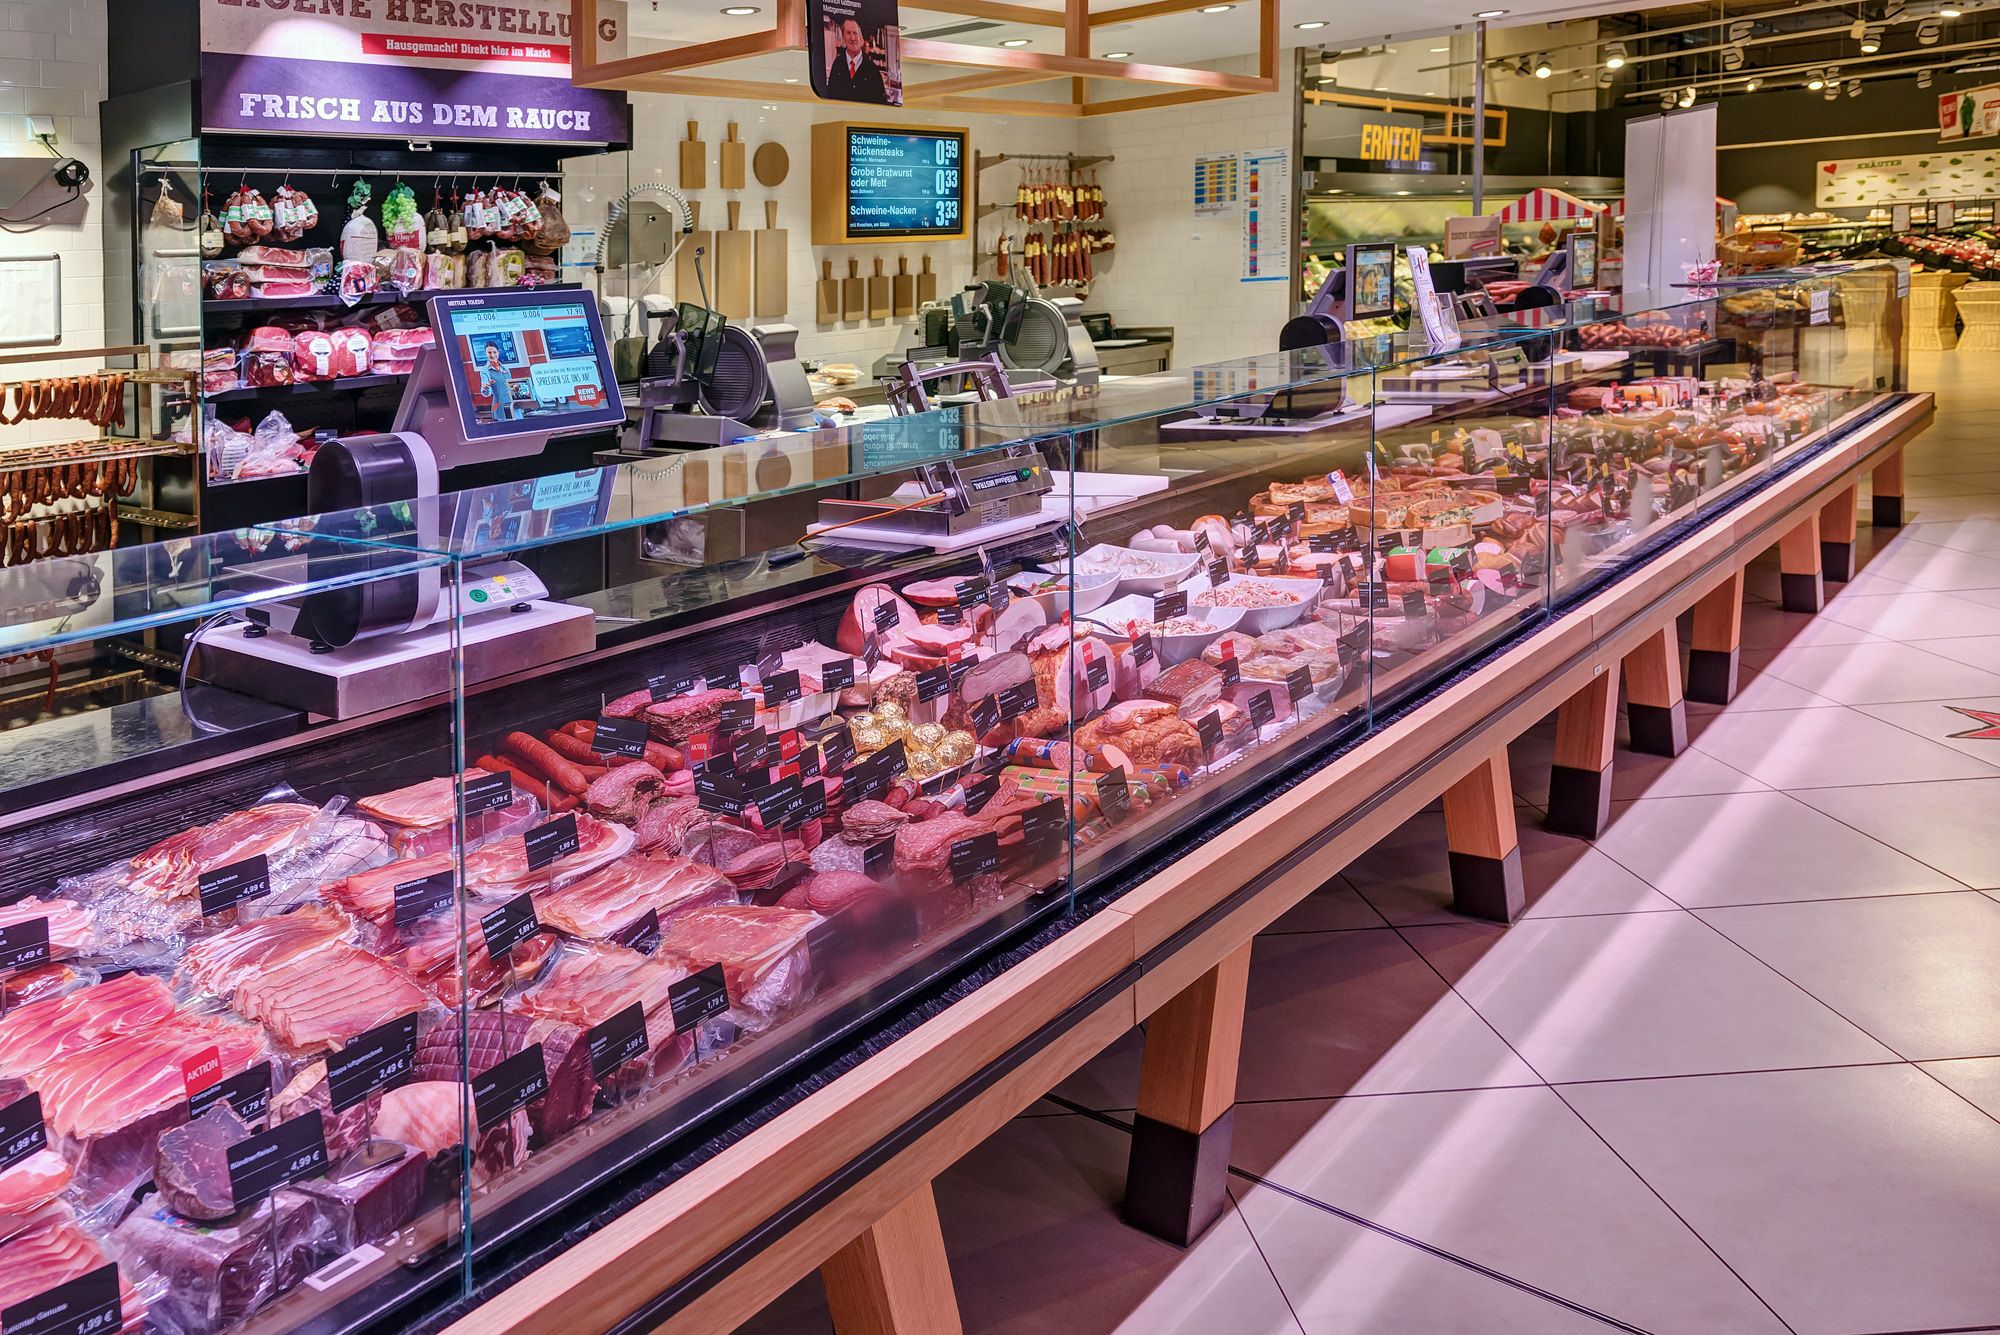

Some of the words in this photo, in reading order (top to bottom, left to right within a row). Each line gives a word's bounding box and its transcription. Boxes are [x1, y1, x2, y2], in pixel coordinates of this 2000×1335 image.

[823, 4, 856, 16] Metzgermeister
[386, 0, 617, 42] HERSTELLUG
[386, 39, 458, 53] Hausgemacht!
[461, 43, 489, 55] Direkt
[491, 45, 509, 56] hier
[512, 46, 524, 57] im
[526, 47, 551, 59] Markt
[240, 93, 360, 121] FRISCH
[371, 100, 423, 124] AUS
[433, 104, 498, 127] DEM
[507, 107, 590, 131] RAUCH
[851, 134, 891, 146] Schweine-
[1361, 124, 1422, 161] ERNTEN
[851, 145, 904, 157] Rückensteaks
[1857, 160, 1902, 169] KRÄUTER
[851, 166, 875, 176] Grobe
[877, 167, 913, 177] Bratwurst
[851, 178, 868, 187] oder
[870, 178, 887, 187] Mett
[850, 205, 917, 216] Schweine-Nacken
[536, 376, 561, 387] SPRECHEN
[561, 375, 571, 385] SIE
[572, 374, 581, 383] UNS
[577, 388, 596, 396] REWE
[624, 744, 636, 752] 1,49
[636, 745, 641, 753] €
[690, 742, 707, 752] AKTION
[782, 740, 797, 751] AKTION
[788, 800, 798, 810] 1,49
[200, 881, 217, 890] Iberico
[217, 874, 239, 885] Schinken
[243, 884, 259, 894] 4,99
[259, 881, 265, 889] €
[395, 878, 428, 891] Schwarzwälder
[530, 922, 534, 930] €
[17, 950, 35, 962] 1,49
[36, 948, 44, 956] €
[719, 994, 724, 1003] €
[626, 1038, 639, 1052] 3,99
[639, 1034, 643, 1044] €
[186, 1058, 218, 1082] AKTION
[329, 1065, 347, 1078] Coppa
[380, 1063, 397, 1079] 2,49
[397, 1059, 403, 1069] €
[520, 1083, 536, 1098] 2,69
[536, 1078, 542, 1088] €
[241, 1099, 260, 1116] 1,79
[260, 1096, 266, 1107] €
[8, 1136, 30, 1155] 1,99
[30, 1131, 39, 1142] €
[230, 1144, 279, 1170] Bündnerfleisch
[290, 1154, 311, 1171] 4,99
[312, 1150, 320, 1161] €
[77, 1314, 103, 1335] 1,99
[104, 1309, 114, 1323] €
